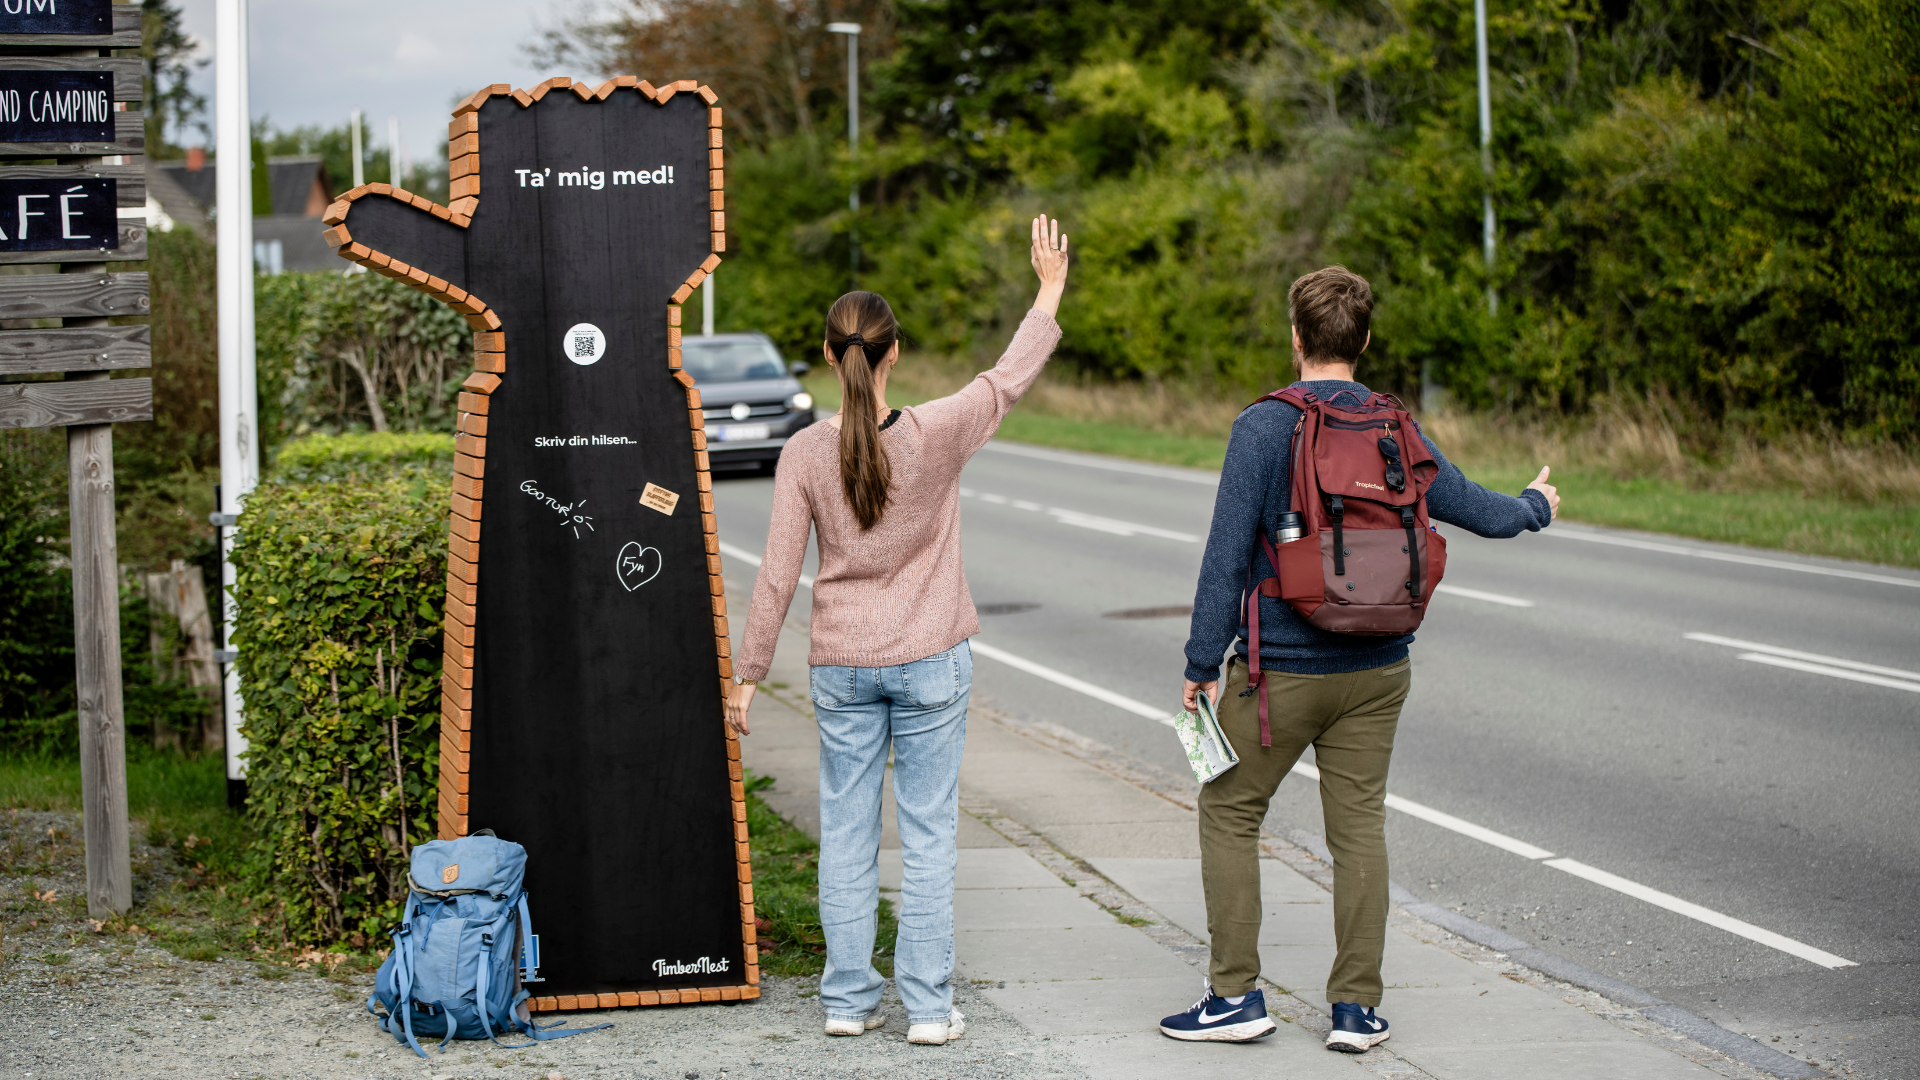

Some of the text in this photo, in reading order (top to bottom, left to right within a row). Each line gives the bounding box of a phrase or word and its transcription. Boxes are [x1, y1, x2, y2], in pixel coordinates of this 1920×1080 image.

[29, 90, 108, 123] CAMPING
[557, 165, 605, 191] mig
[612, 164, 675, 186] med!
[0, 185, 91, 240] FÉ
[534, 435, 567, 447] Skriv
[568, 435, 589, 446] din
[622, 556, 645, 577] Fyn
[652, 956, 731, 978] TimberNest
